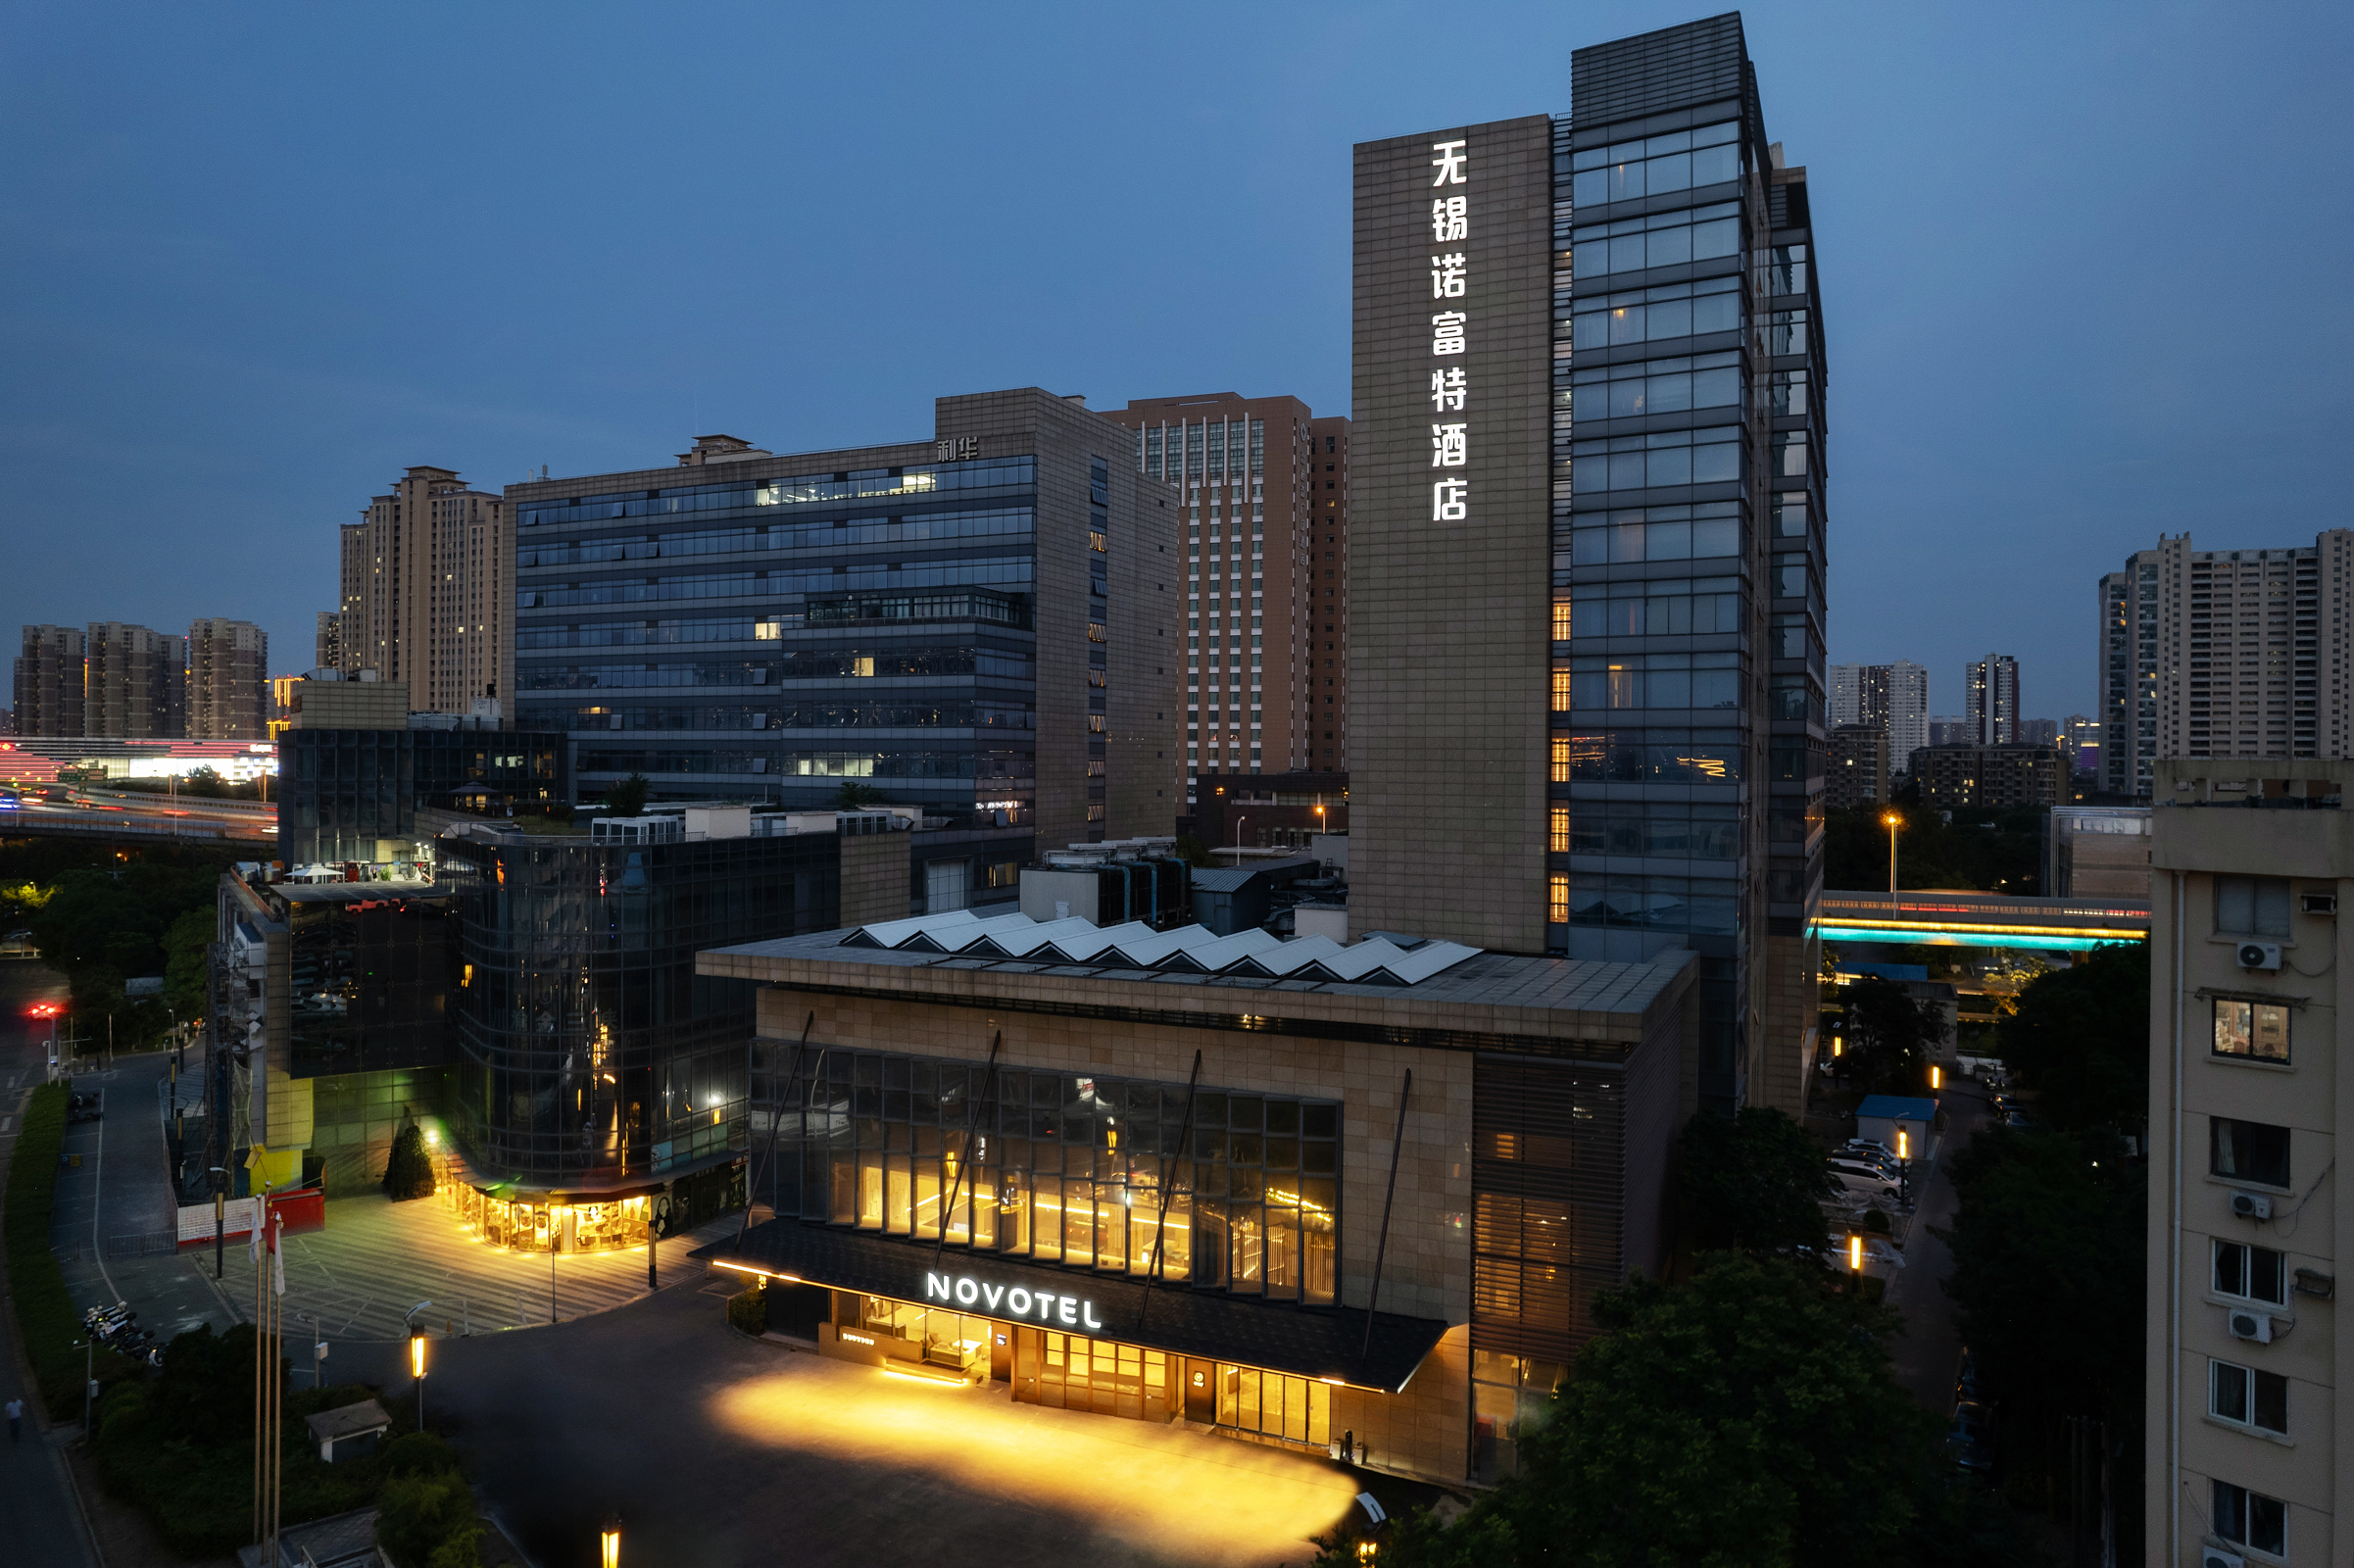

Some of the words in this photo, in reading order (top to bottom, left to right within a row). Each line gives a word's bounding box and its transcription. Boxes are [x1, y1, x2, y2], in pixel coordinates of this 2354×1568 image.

[1432, 139, 1468, 521] 无锡诺富特酒店
[937, 436, 978, 463] 利华
[927, 1272, 1102, 1329] NOVOTEL
